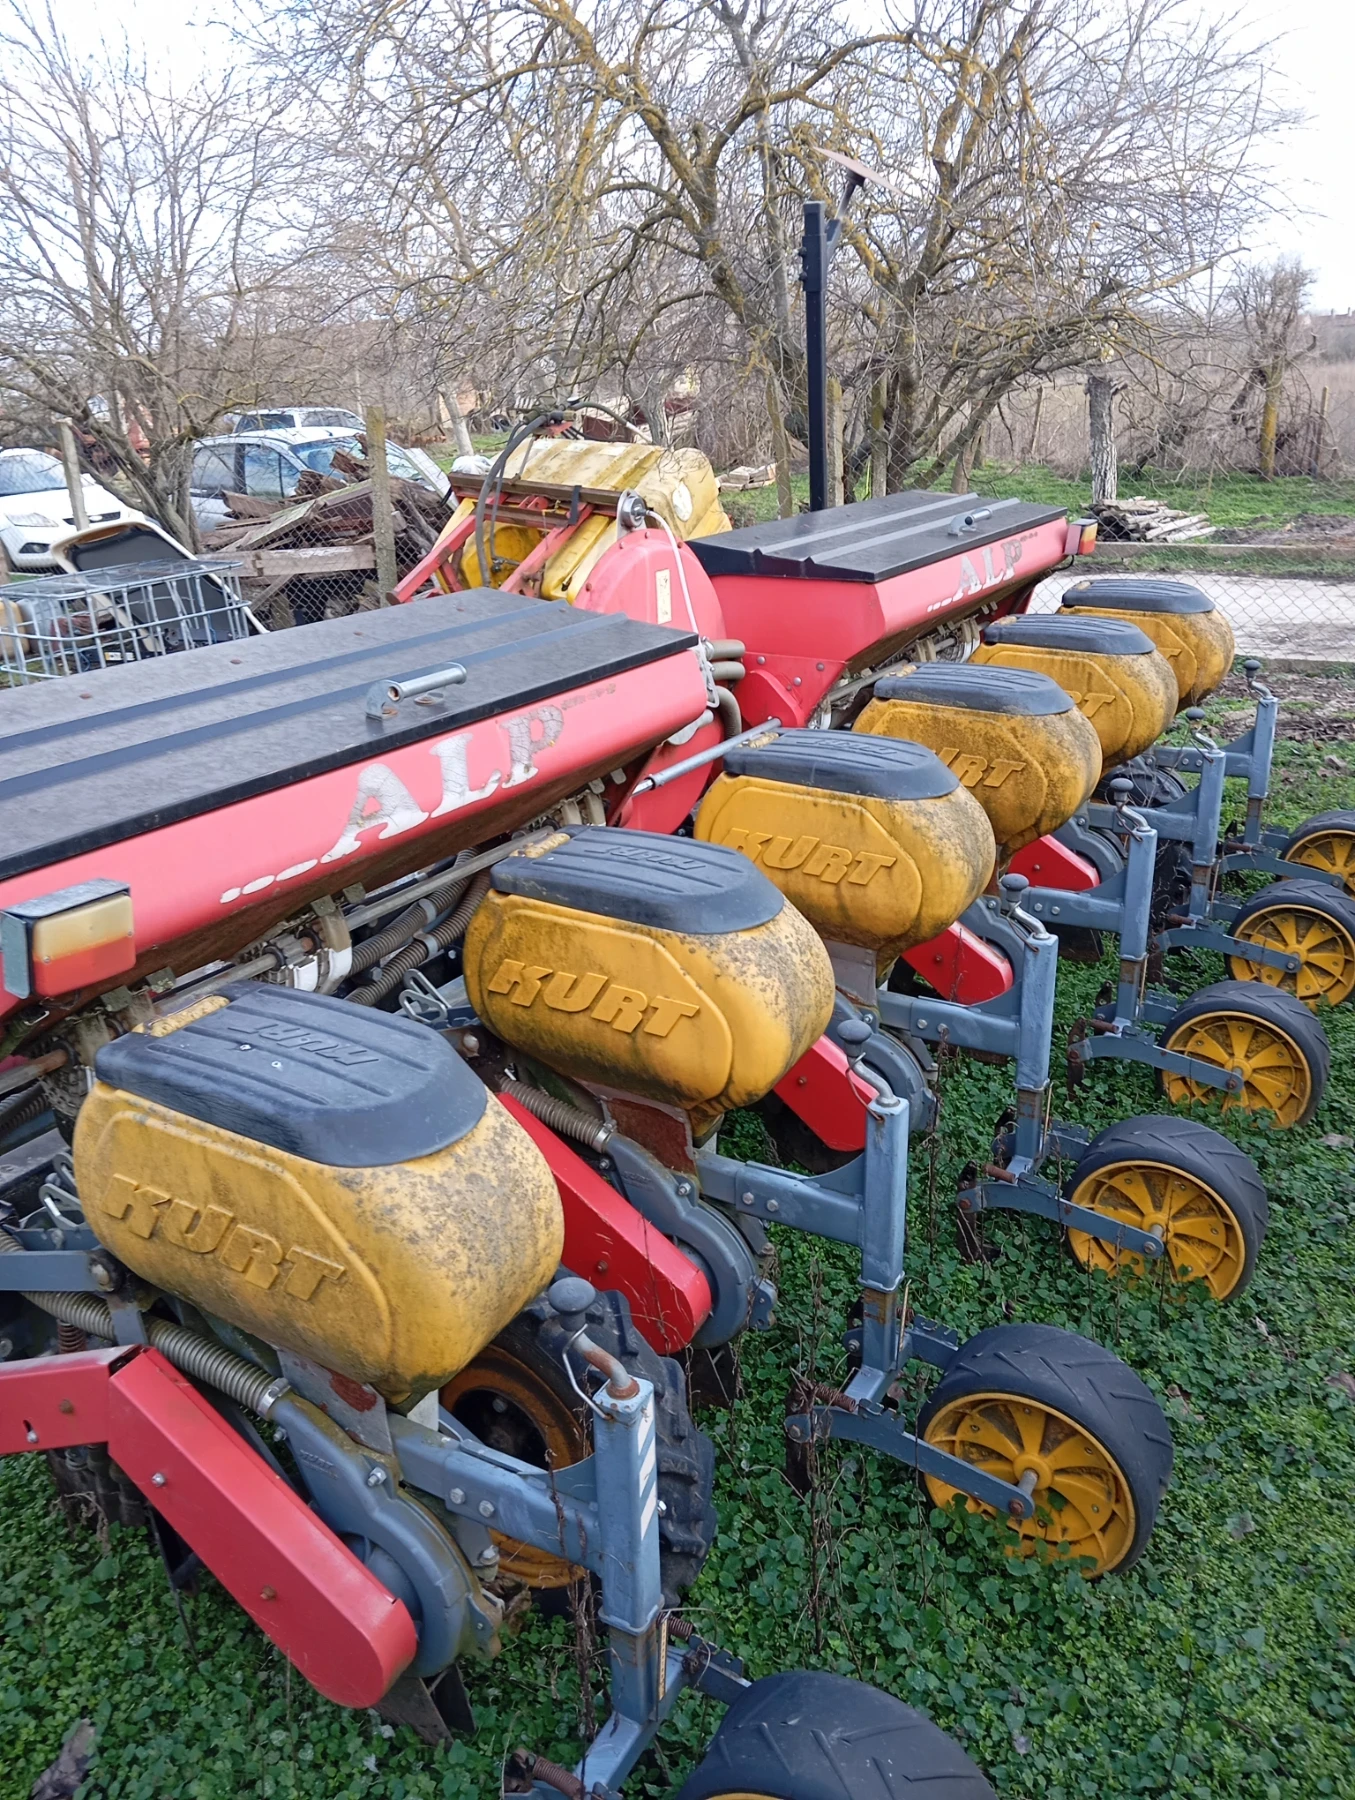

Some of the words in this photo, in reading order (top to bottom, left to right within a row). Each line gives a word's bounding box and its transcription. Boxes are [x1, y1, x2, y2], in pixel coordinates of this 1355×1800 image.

[953, 539, 1022, 601] ALP
[320, 704, 565, 864] ALP
[935, 747, 1027, 788] RT
[721, 827, 898, 886] KURT
[487, 958, 701, 1038] KURT
[101, 1173, 347, 1301] KURT
